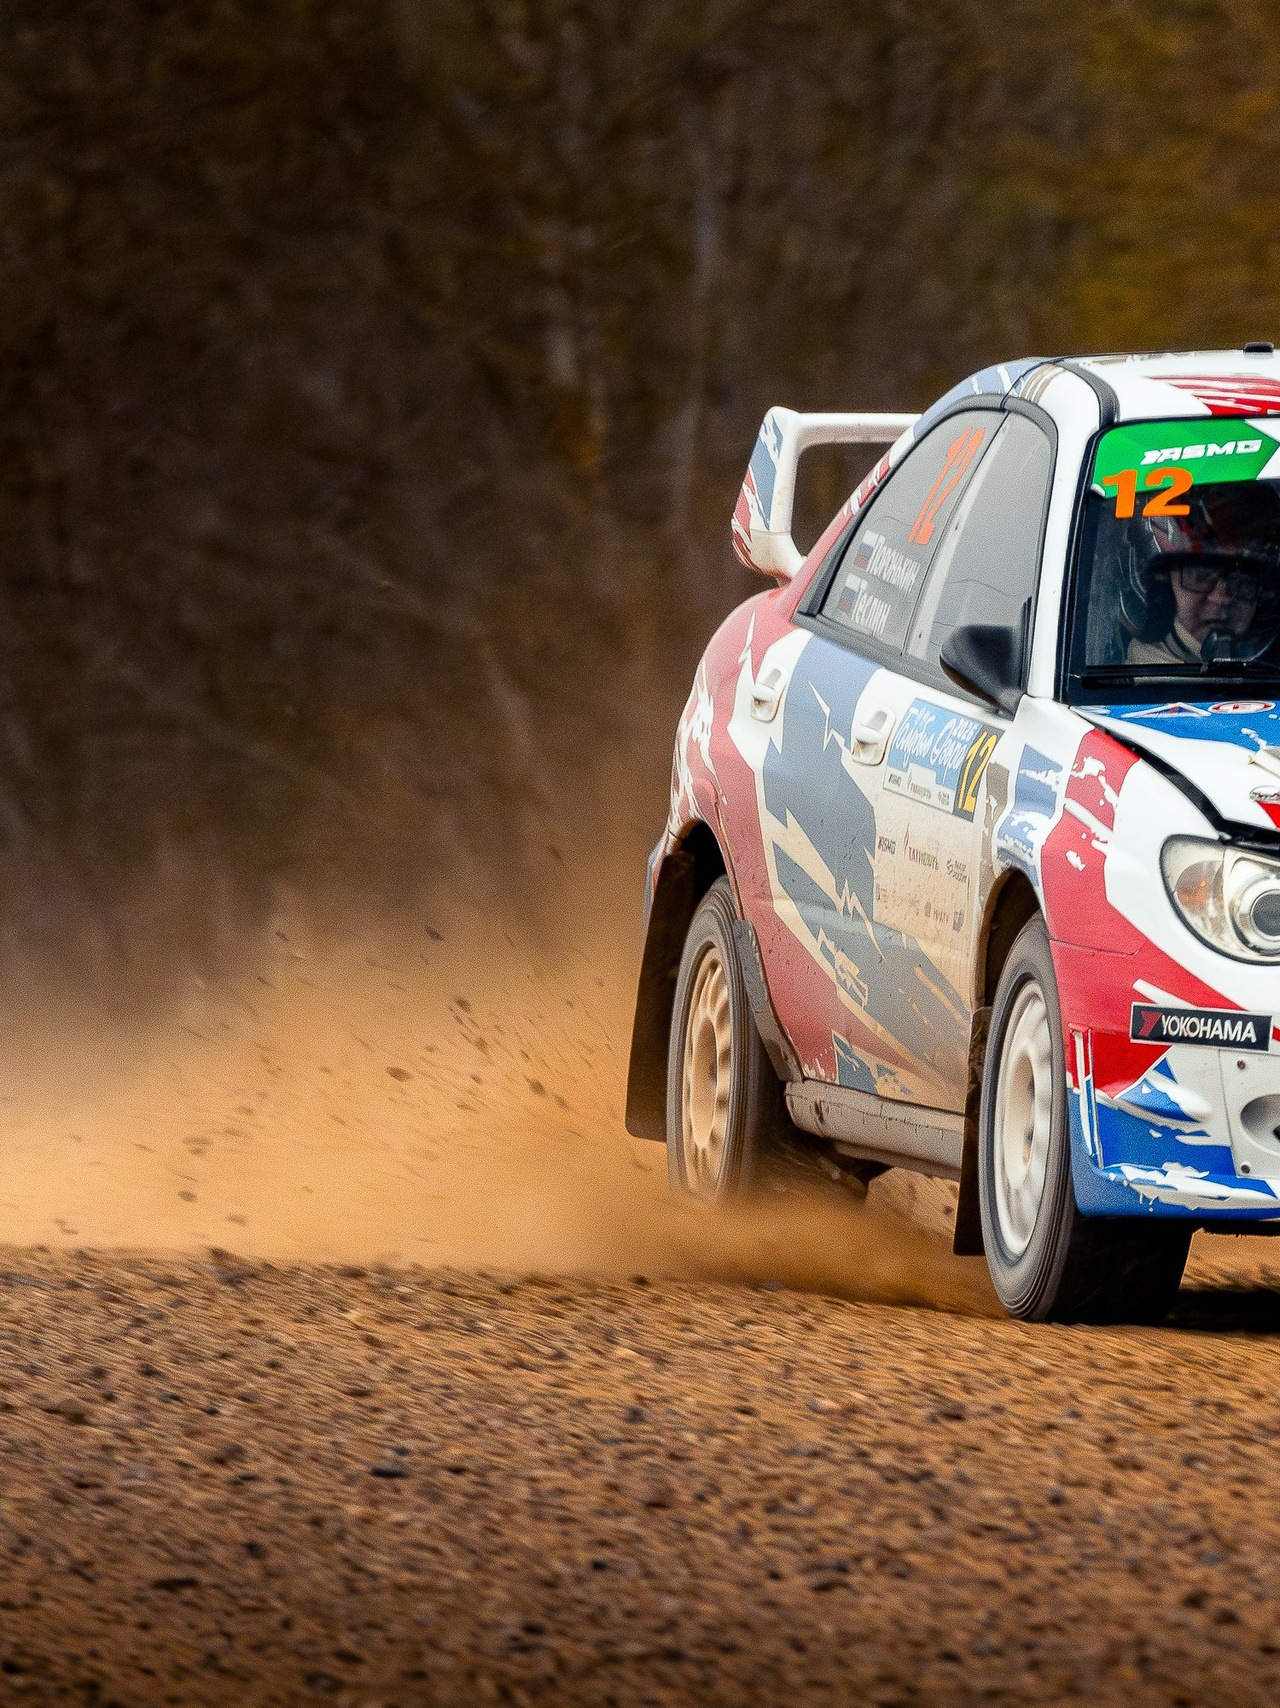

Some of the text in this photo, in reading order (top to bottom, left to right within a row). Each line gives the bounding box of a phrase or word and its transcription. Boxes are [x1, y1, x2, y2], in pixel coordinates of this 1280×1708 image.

[907, 427, 985, 545] 12
[1102, 466, 1193, 519] 12
[958, 731, 997, 813] 12
[1161, 1014, 1257, 1044] YOKOHAMA
